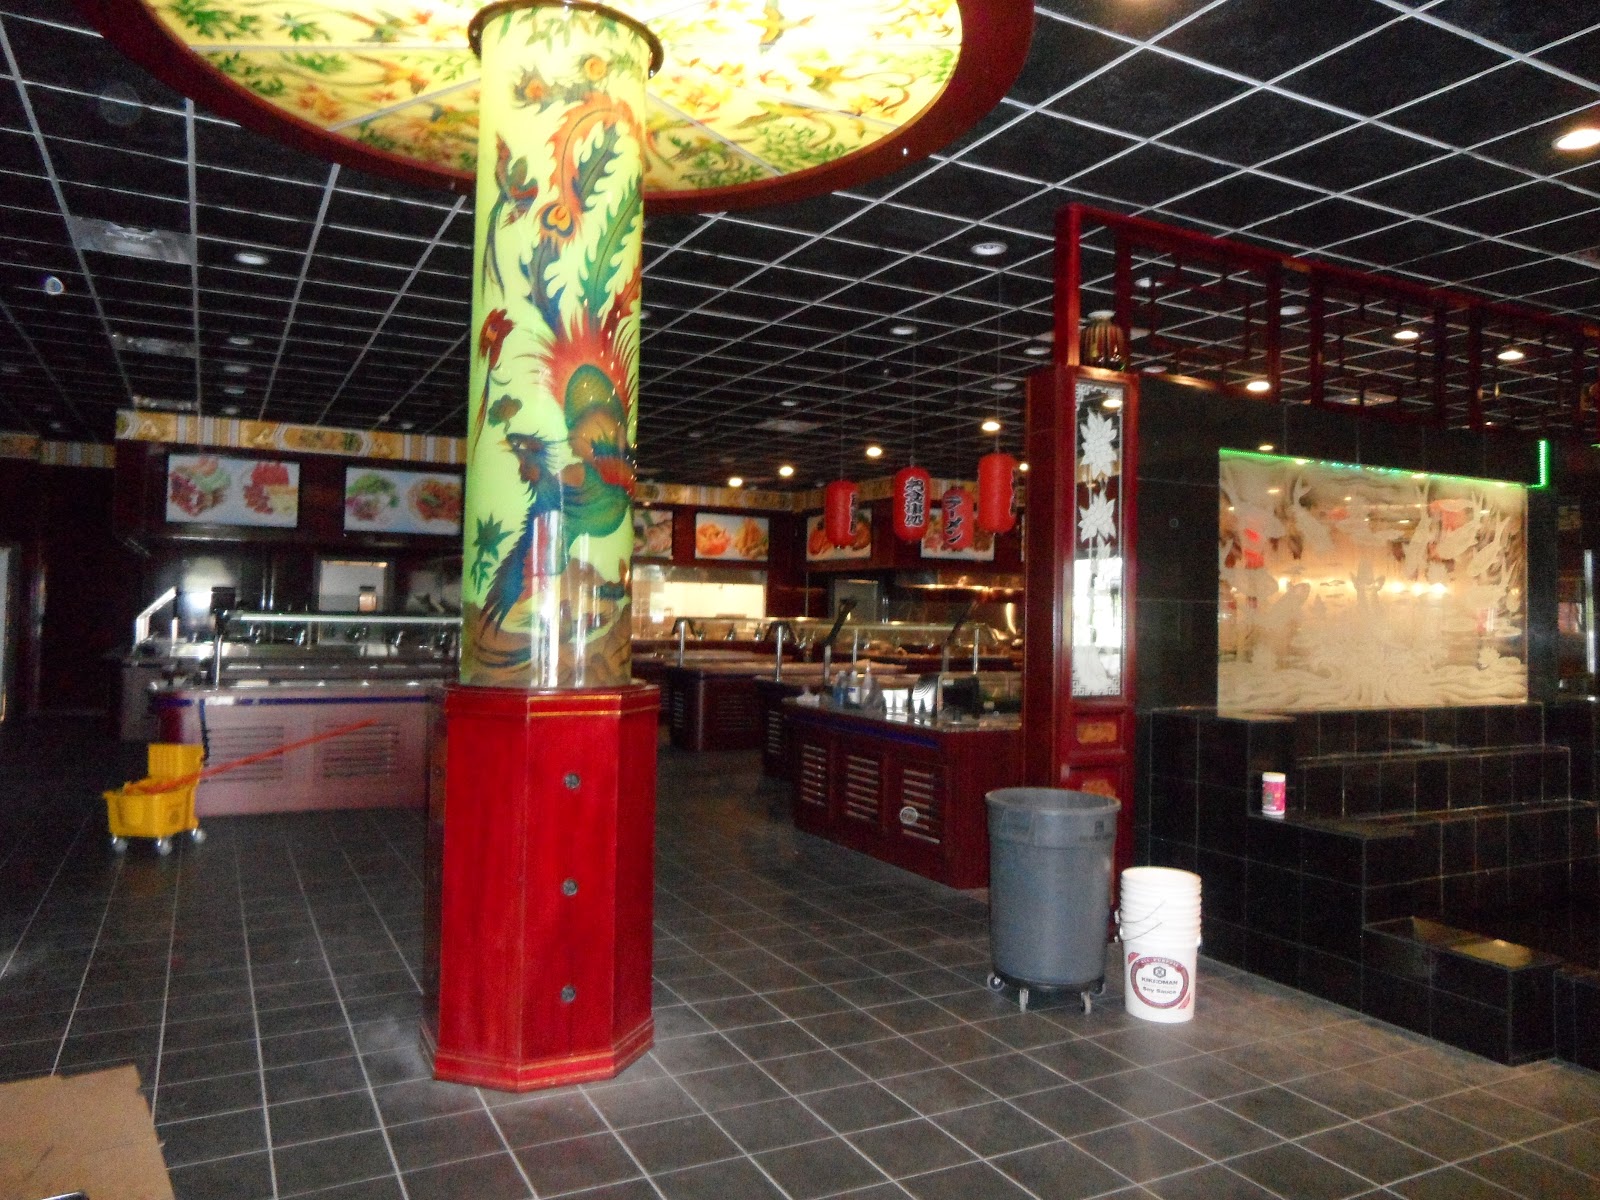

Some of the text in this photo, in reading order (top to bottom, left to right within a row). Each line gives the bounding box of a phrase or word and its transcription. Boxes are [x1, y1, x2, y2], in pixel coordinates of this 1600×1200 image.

[945, 495, 963, 544] ラーメン
[1141, 977, 1178, 985] KIKKOMAN
